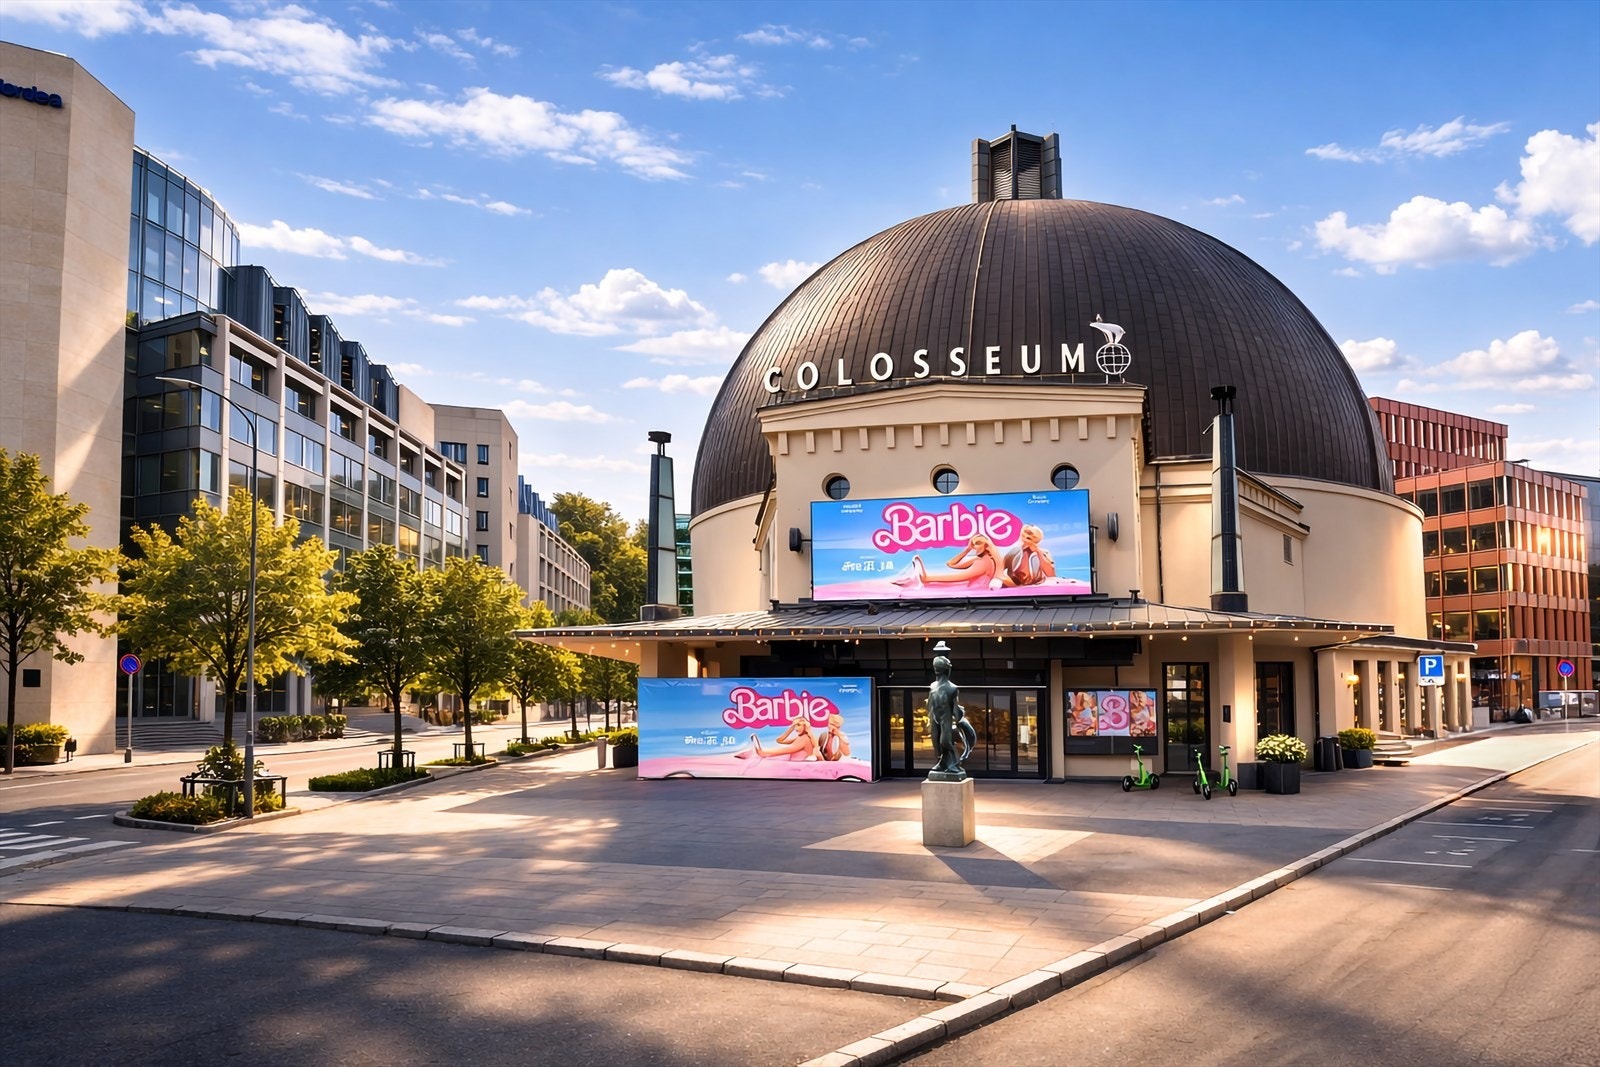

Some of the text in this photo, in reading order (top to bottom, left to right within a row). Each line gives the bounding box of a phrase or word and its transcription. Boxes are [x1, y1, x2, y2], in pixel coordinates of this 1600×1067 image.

[763, 342, 1086, 394] COLOSSEUM
[874, 504, 1012, 547] Barbie
[1425, 658, 1437, 675] P
[723, 688, 831, 724] Barbie
